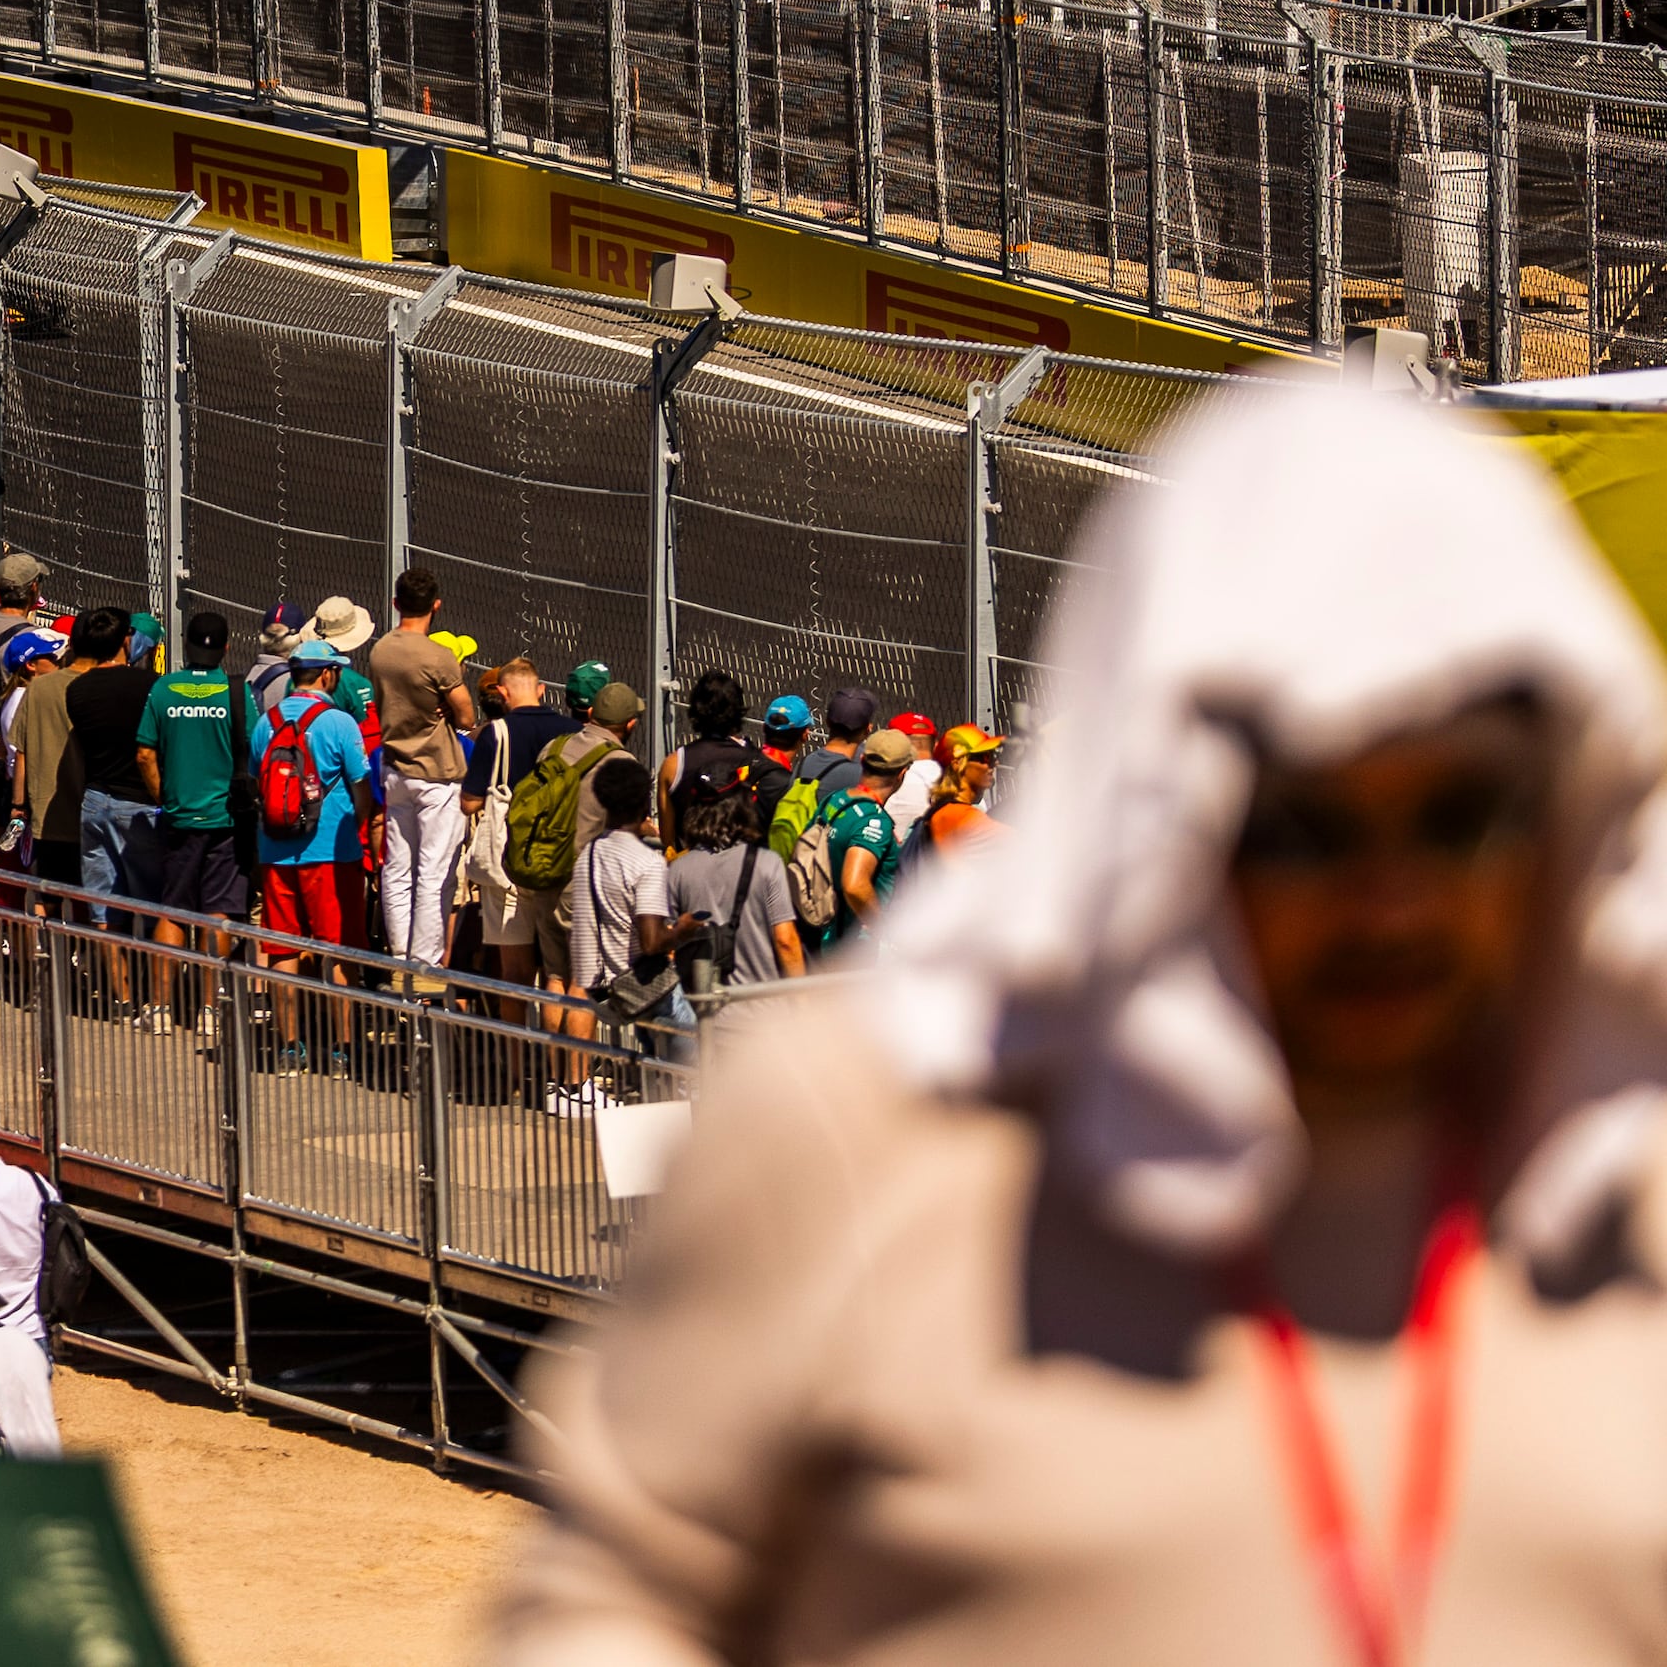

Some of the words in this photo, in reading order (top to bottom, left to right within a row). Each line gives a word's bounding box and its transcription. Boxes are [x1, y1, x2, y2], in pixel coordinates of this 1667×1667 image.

[174, 133, 349, 244] PIRELLI
[550, 192, 734, 296] PIRE
[167, 706, 227, 718] aramco
